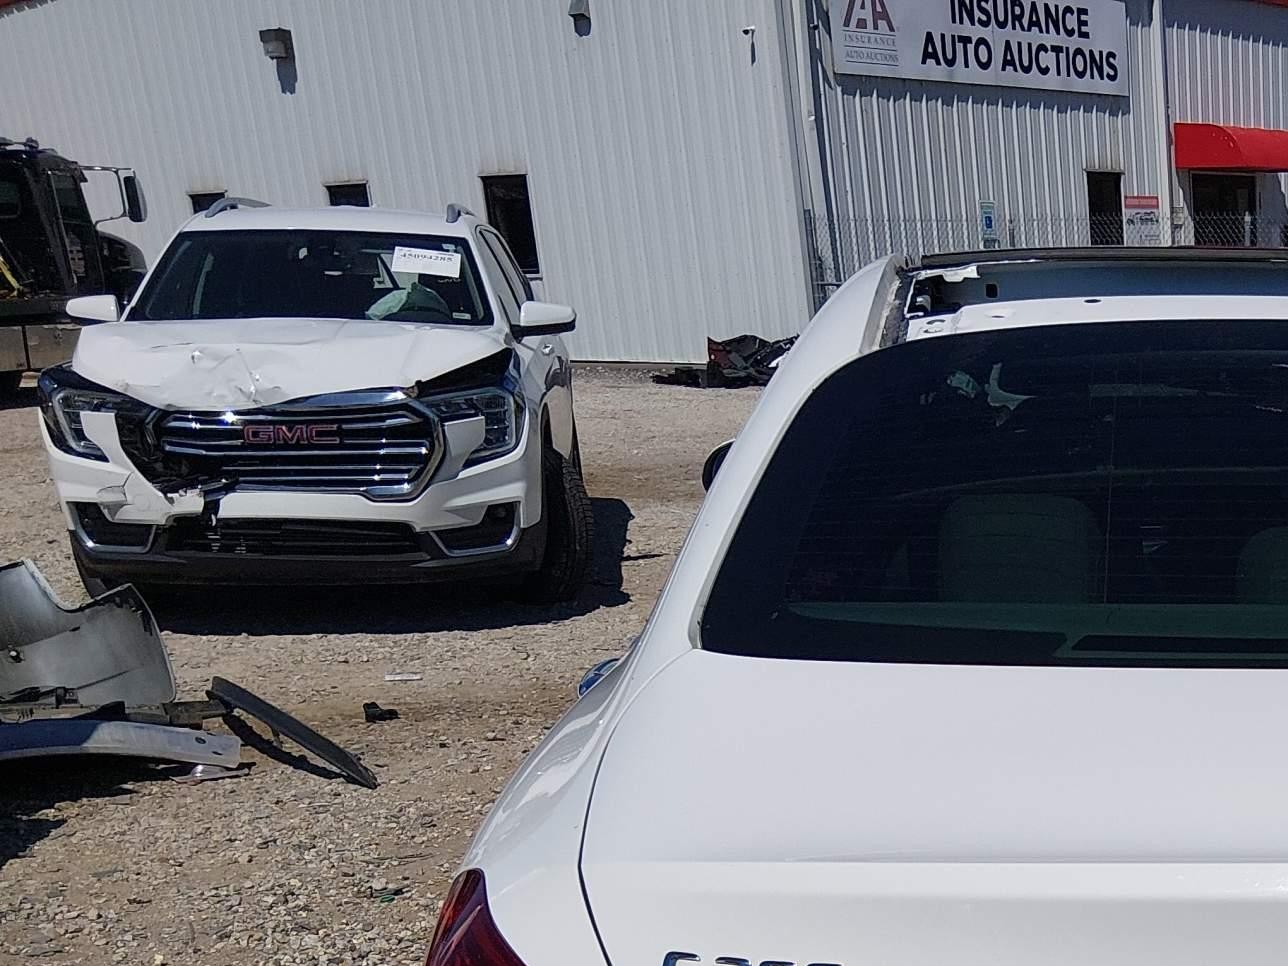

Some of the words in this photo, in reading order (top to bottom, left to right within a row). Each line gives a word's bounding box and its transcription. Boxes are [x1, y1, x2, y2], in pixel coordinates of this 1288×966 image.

[950, 0, 1091, 39] INSURANCE
[844, 33, 897, 47] INSURANCE
[921, 31, 993, 71] AUTO
[1001, 39, 1119, 82] AUCTIONS
[244, 425, 340, 444] GMC
